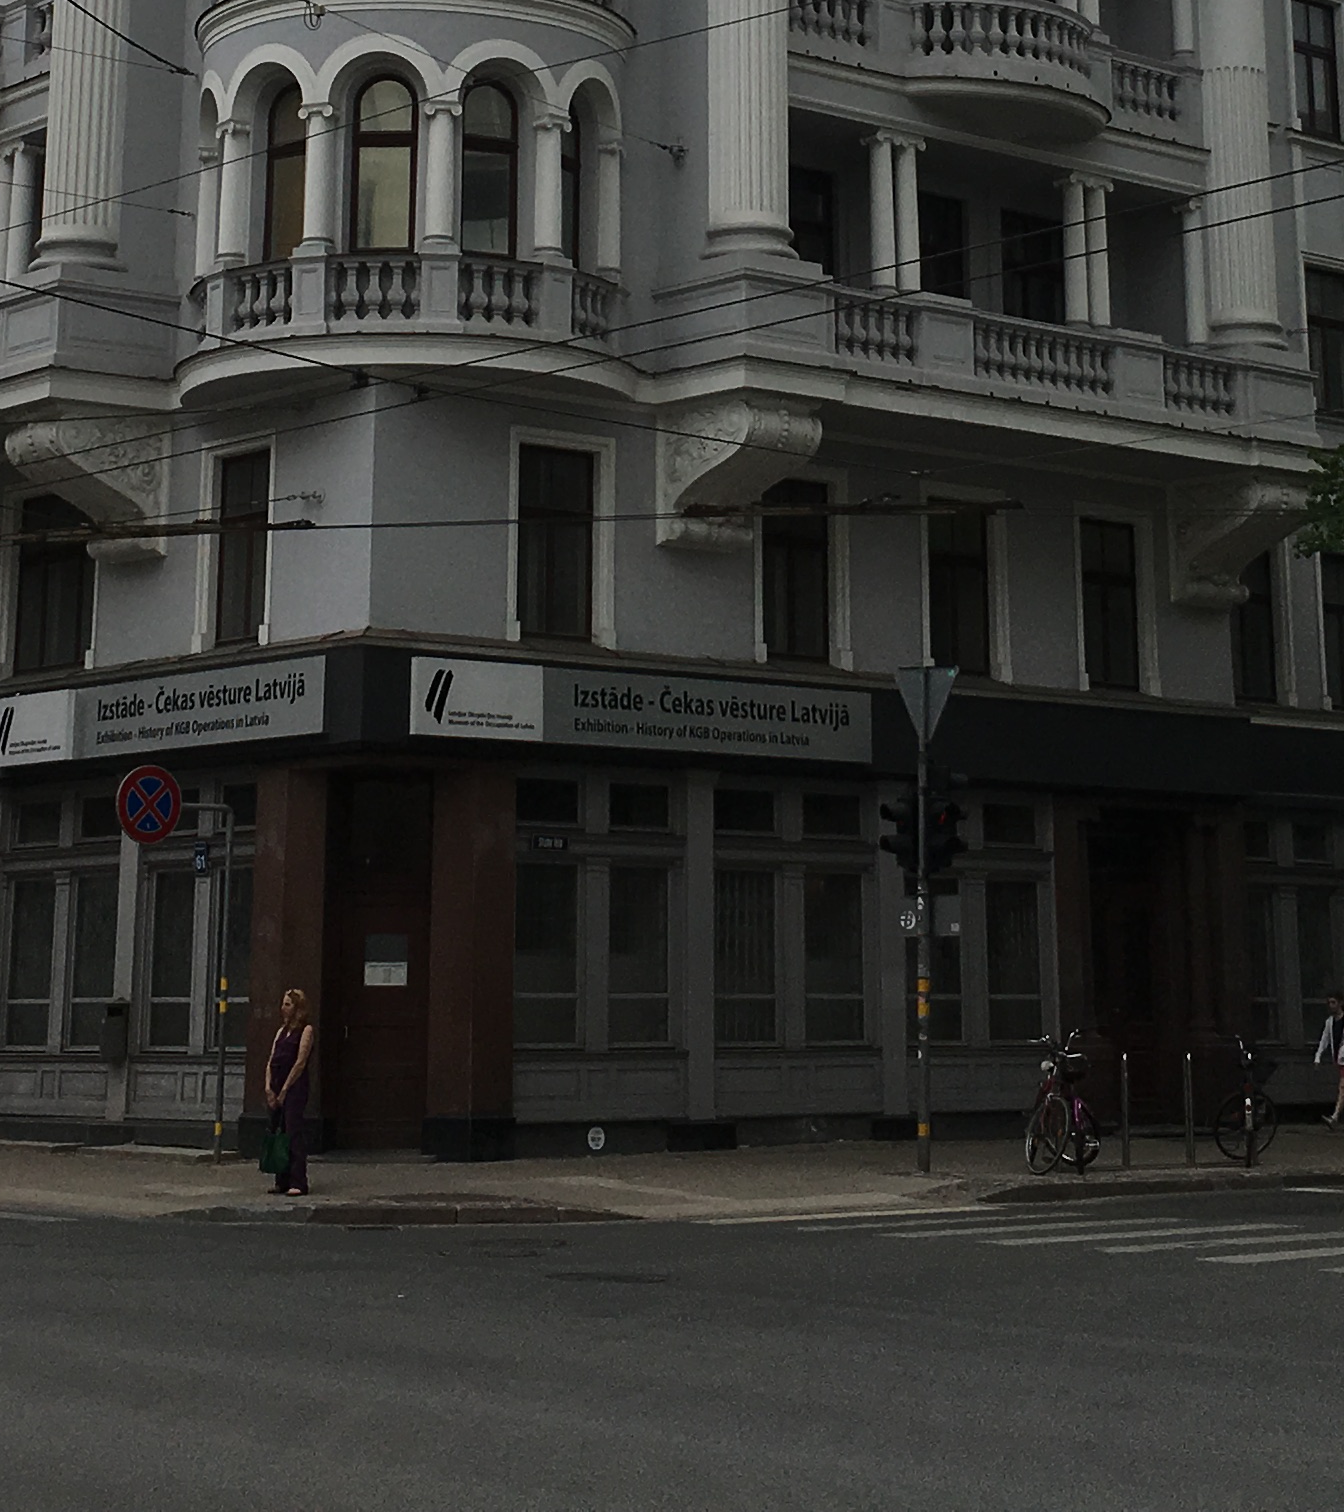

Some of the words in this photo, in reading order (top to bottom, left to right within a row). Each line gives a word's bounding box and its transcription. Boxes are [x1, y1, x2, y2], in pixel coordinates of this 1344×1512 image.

[97, 693, 145, 722] Izstāde
[156, 685, 196, 715] Čekas
[199, 684, 252, 708] vēsture
[255, 672, 305, 705] Latvijā
[574, 683, 644, 712] Izstāde
[659, 684, 715, 717] Čekas
[719, 696, 787, 722] vēsture
[791, 699, 850, 732] Latvijā
[97, 728, 133, 745] Exhibition
[138, 725, 165, 740] History
[165, 722, 174, 737] of
[175, 720, 191, 736] KGB
[191, 717, 235, 737] Operations
[236, 717, 244, 729] in
[244, 711, 270, 729] Latvia
[574, 718, 628, 735] Exhibition
[636, 722, 674, 740] History
[676, 725, 687, 738] of
[688, 727, 710, 740] KGB
[712, 727, 767, 744] Operations
[768, 731, 778, 744] in
[780, 732, 810, 747] Latvia
